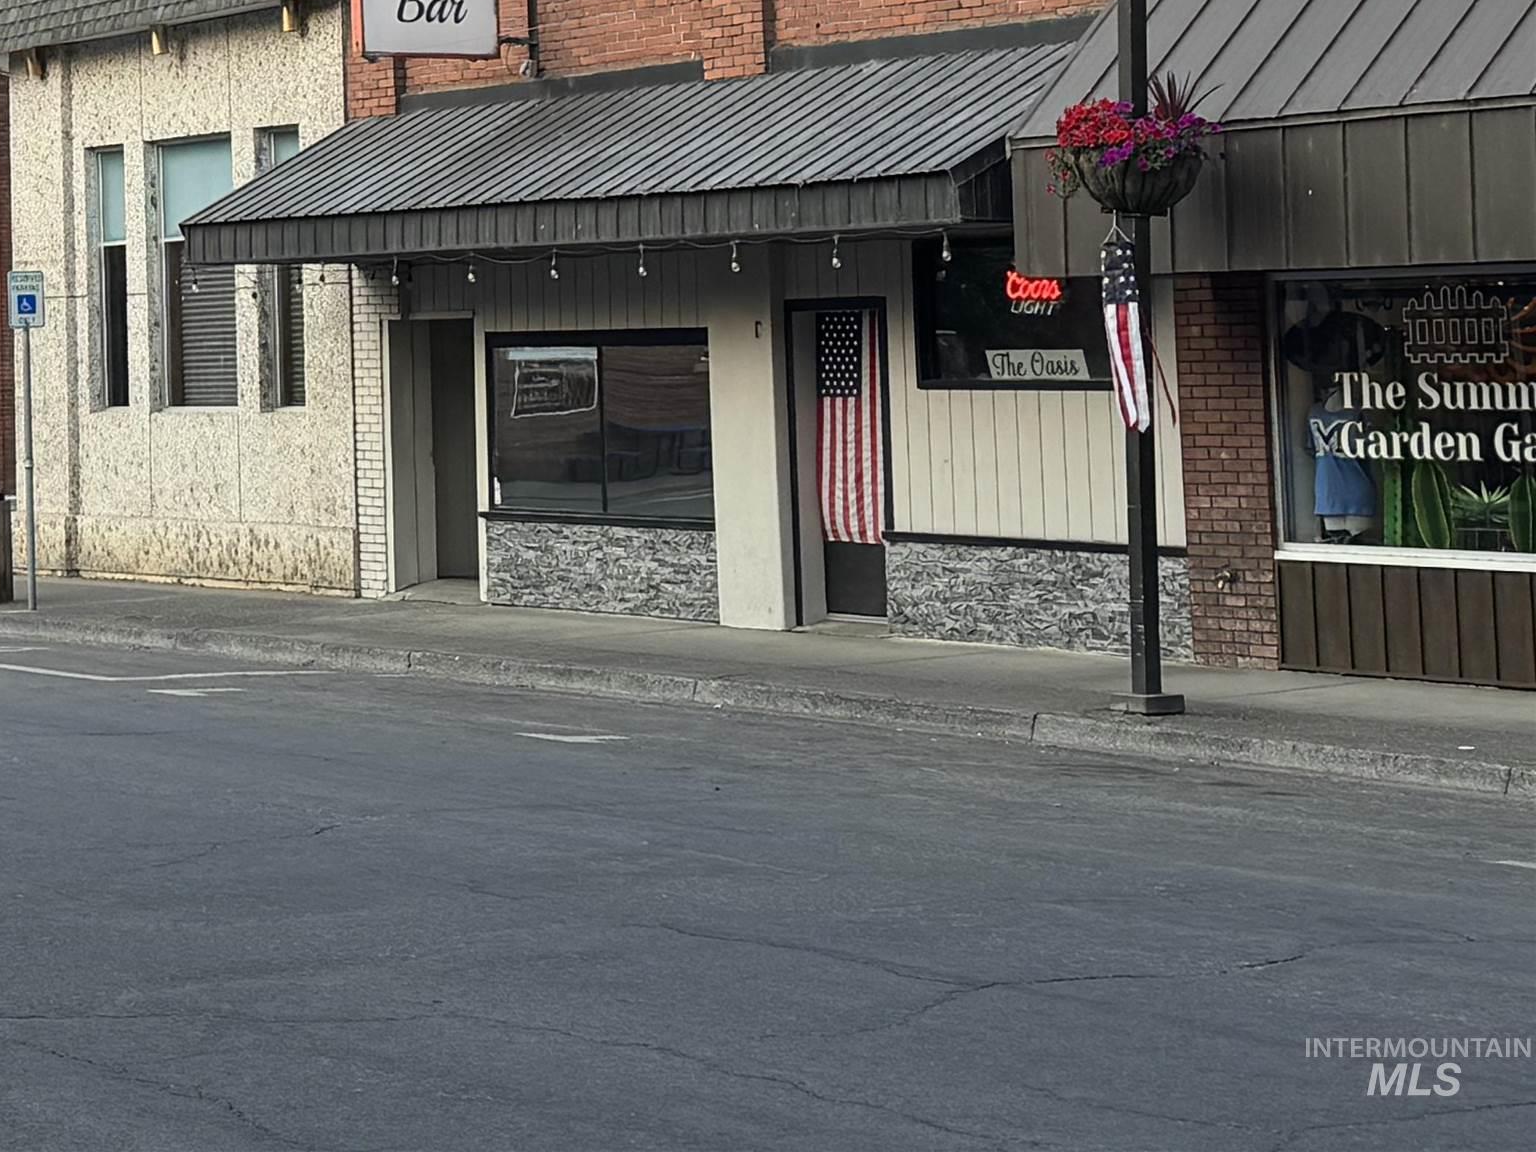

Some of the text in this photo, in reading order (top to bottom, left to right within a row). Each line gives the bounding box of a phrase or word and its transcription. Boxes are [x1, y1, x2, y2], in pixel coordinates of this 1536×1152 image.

[1006, 270, 1062, 300] Coors
[1010, 300, 1058, 316] LIGHT
[992, 351, 1080, 377] The Oasis
[1334, 371, 1536, 410] The Summ
[1340, 420, 1536, 462] Garden Ga
